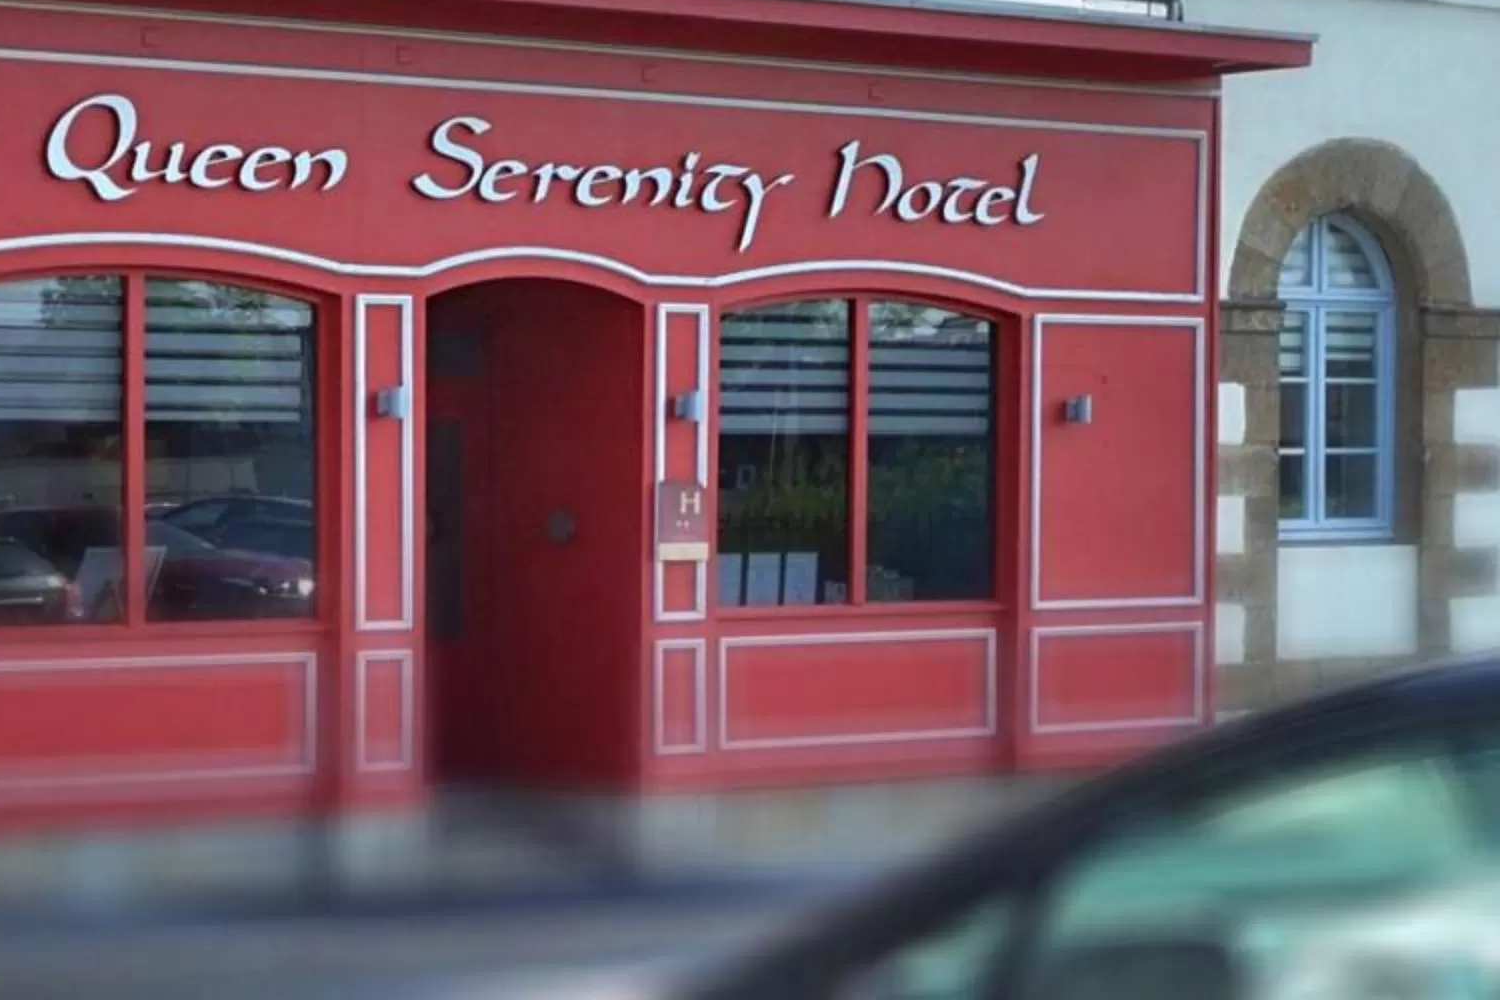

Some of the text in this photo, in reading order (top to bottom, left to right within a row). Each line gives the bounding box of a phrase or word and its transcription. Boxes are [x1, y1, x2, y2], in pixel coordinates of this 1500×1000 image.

[46, 94, 348, 201] Queen
[413, 116, 795, 254] Serenity
[680, 491, 700, 514] H
